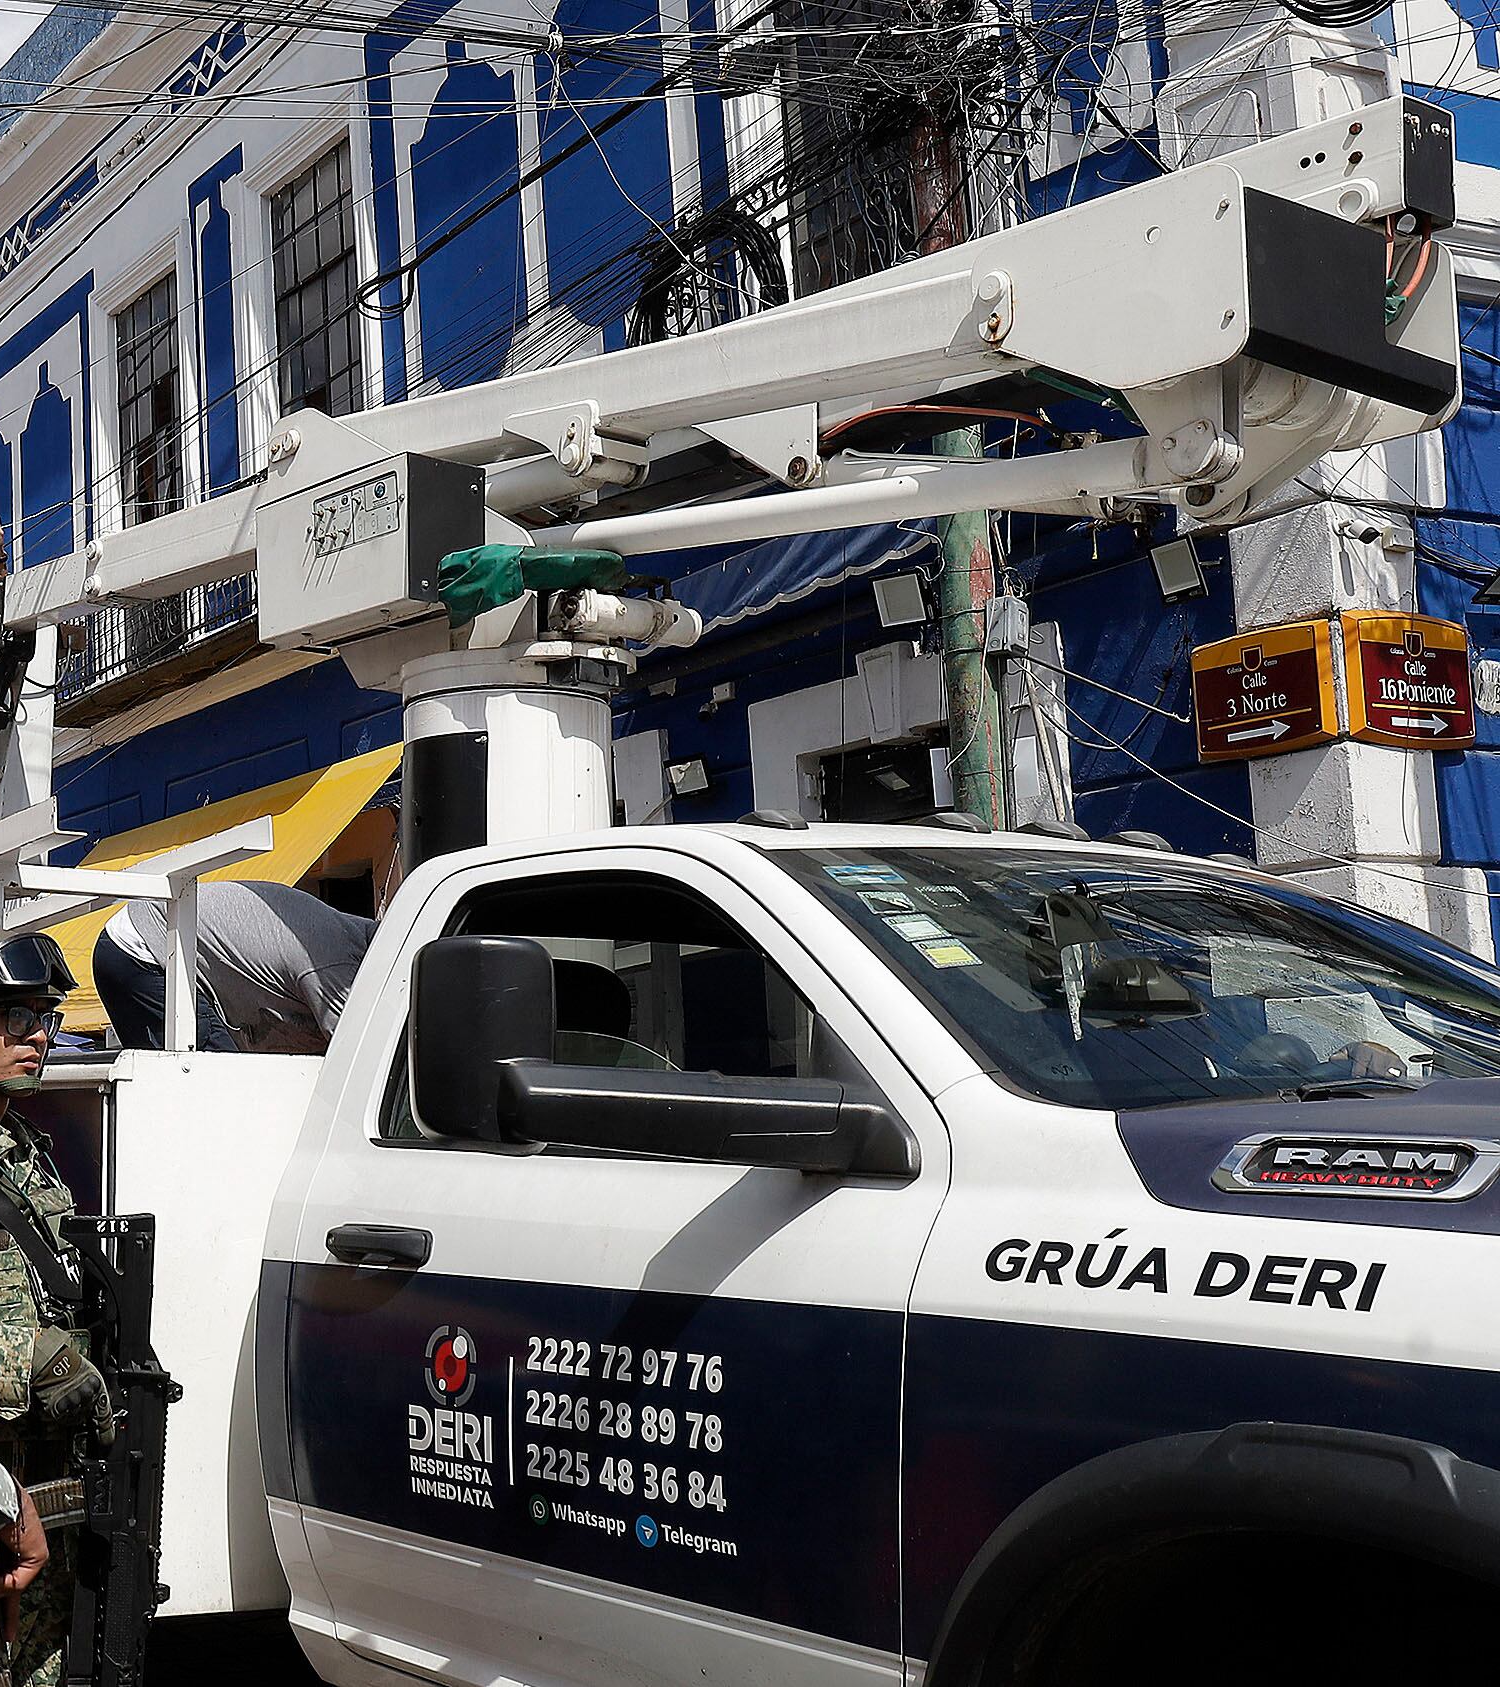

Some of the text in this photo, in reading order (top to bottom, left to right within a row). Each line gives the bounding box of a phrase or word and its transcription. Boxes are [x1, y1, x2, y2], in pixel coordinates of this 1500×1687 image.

[1242, 673, 1267, 690] Calle
[1404, 660, 1427, 677] Calle
[1227, 692, 1287, 718] 3 Norte
[1379, 678, 1457, 705] 16 Poniente
[1273, 1147, 1459, 1173] RAM
[1260, 1170, 1442, 1189] HEAVY DUTY
[96, 1219, 129, 1233] 312
[985, 1228, 1386, 1313] GRÚA DERI
[526, 1336, 723, 1393] 2222 72 97 76
[409, 1404, 493, 1463] DERI
[525, 1389, 723, 1452] 2226 28 89 78
[410, 1455, 493, 1486] RESPUESTA
[526, 1443, 727, 1513] 2225 48 36 84
[411, 1477, 495, 1509] INMEDIATA
[552, 1502, 738, 1557] Whatsapp Telegram
